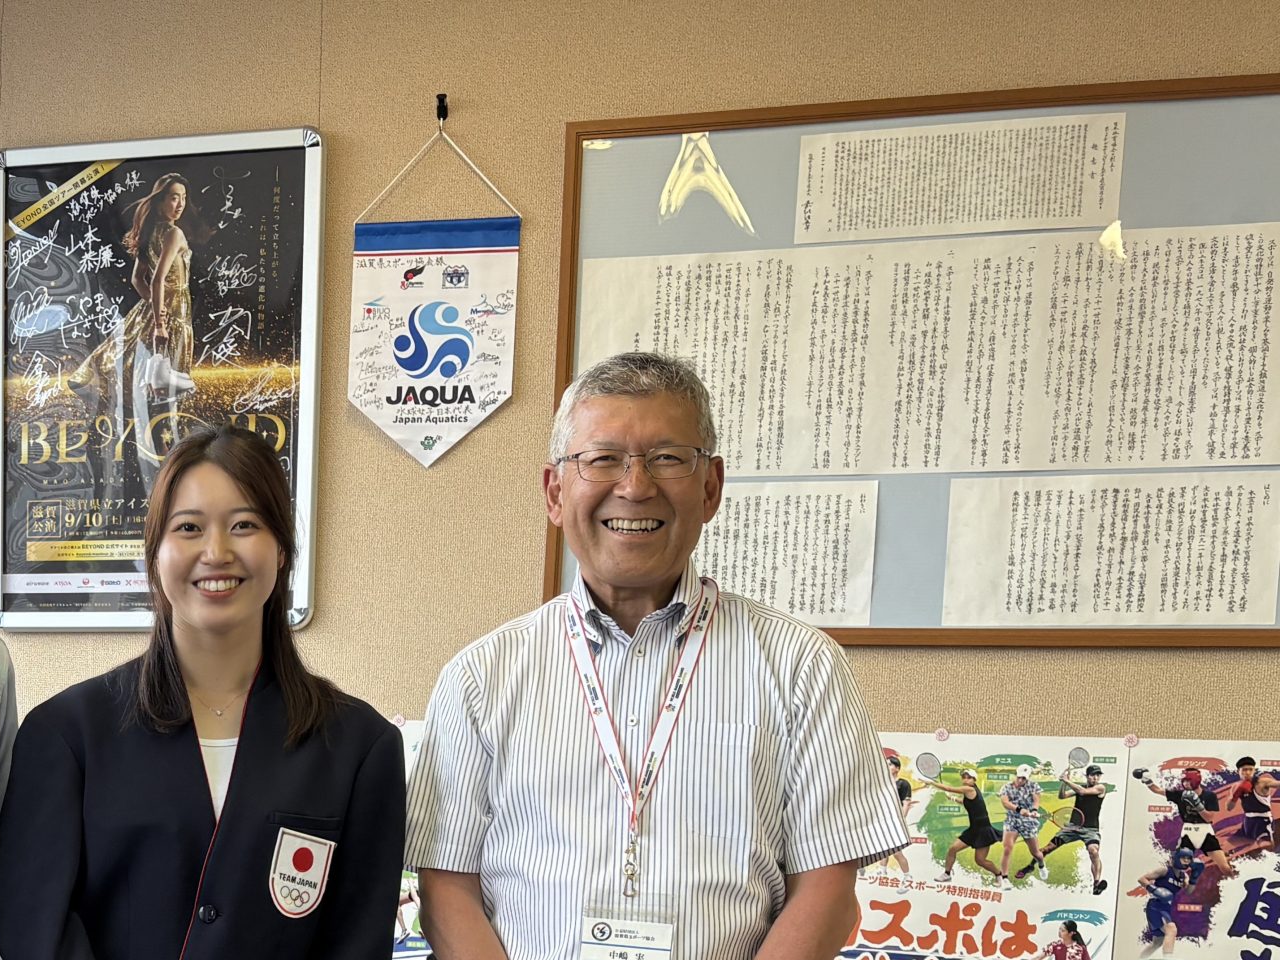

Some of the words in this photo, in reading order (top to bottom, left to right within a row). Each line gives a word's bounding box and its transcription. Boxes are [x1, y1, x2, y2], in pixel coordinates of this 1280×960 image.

[386, 385, 476, 407] JAQUA
[393, 415, 422, 425] Japan
[426, 414, 469, 425] Aquatics
[19, 412, 287, 465] BEYOD
[65, 512, 103, 528] 9/10
[1177, 760, 1209, 768] ボクシング
[279, 872, 297, 884] TEAM
[297, 878, 319, 890] JAPAN
[904, 880, 1003, 904] スポーツ特別指導員
[1057, 911, 1091, 921] バドミントン
[847, 899, 1038, 959] スポは
